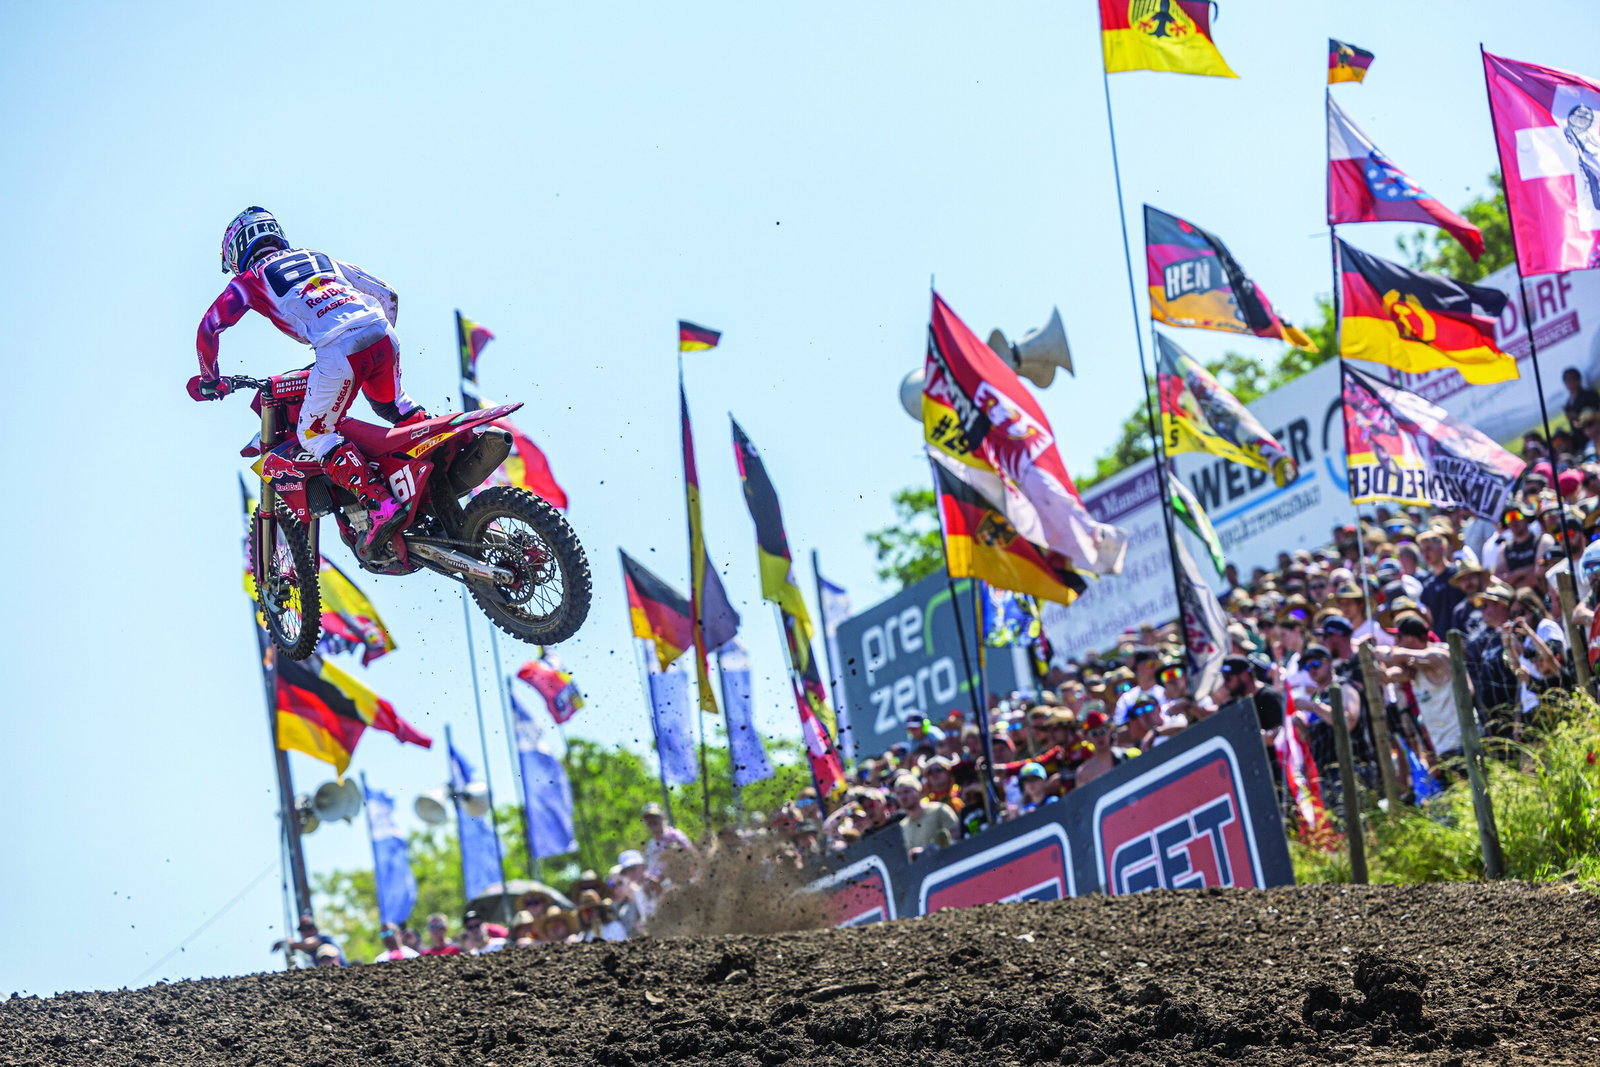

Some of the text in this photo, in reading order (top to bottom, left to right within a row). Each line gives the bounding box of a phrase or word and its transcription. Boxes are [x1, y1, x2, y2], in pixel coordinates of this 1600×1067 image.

[305, 291, 331, 309] Red
[316, 295, 358, 318] GASGAS
[276, 379, 307, 388] RENTHA
[276, 384, 307, 394] RENTHA
[331, 379, 351, 412] GASGAS
[1190, 416, 1313, 513] WEBR
[289, 482, 304, 491] Bull
[389, 464, 417, 502] 61
[861, 604, 924, 687] pre
[869, 656, 959, 736] zero
